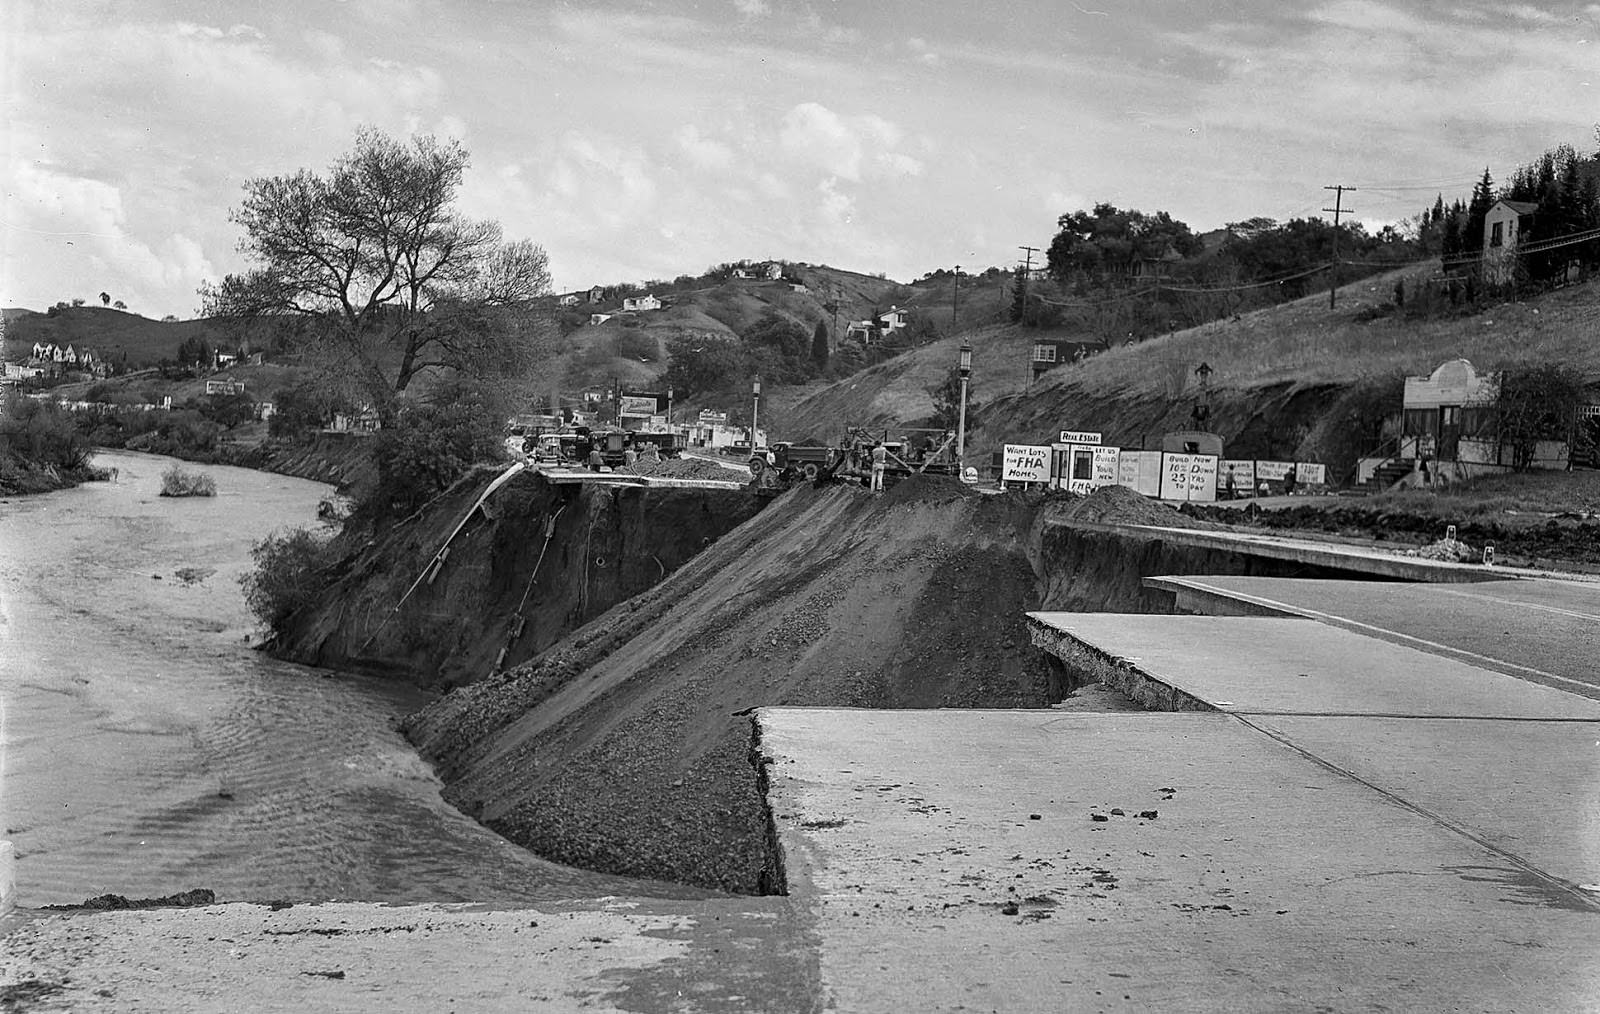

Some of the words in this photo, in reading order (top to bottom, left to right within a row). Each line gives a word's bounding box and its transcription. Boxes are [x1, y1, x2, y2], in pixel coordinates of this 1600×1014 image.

[1029, 447, 1047, 458] LOTS
[1017, 457, 1044, 469] FHA
[1095, 454, 1117, 463] BUILD
[1008, 468, 1038, 480] HOMES
[1095, 464, 1114, 474] YOUR
[1191, 464, 1215, 474] DOWN
[1171, 473, 1186, 482] 25
